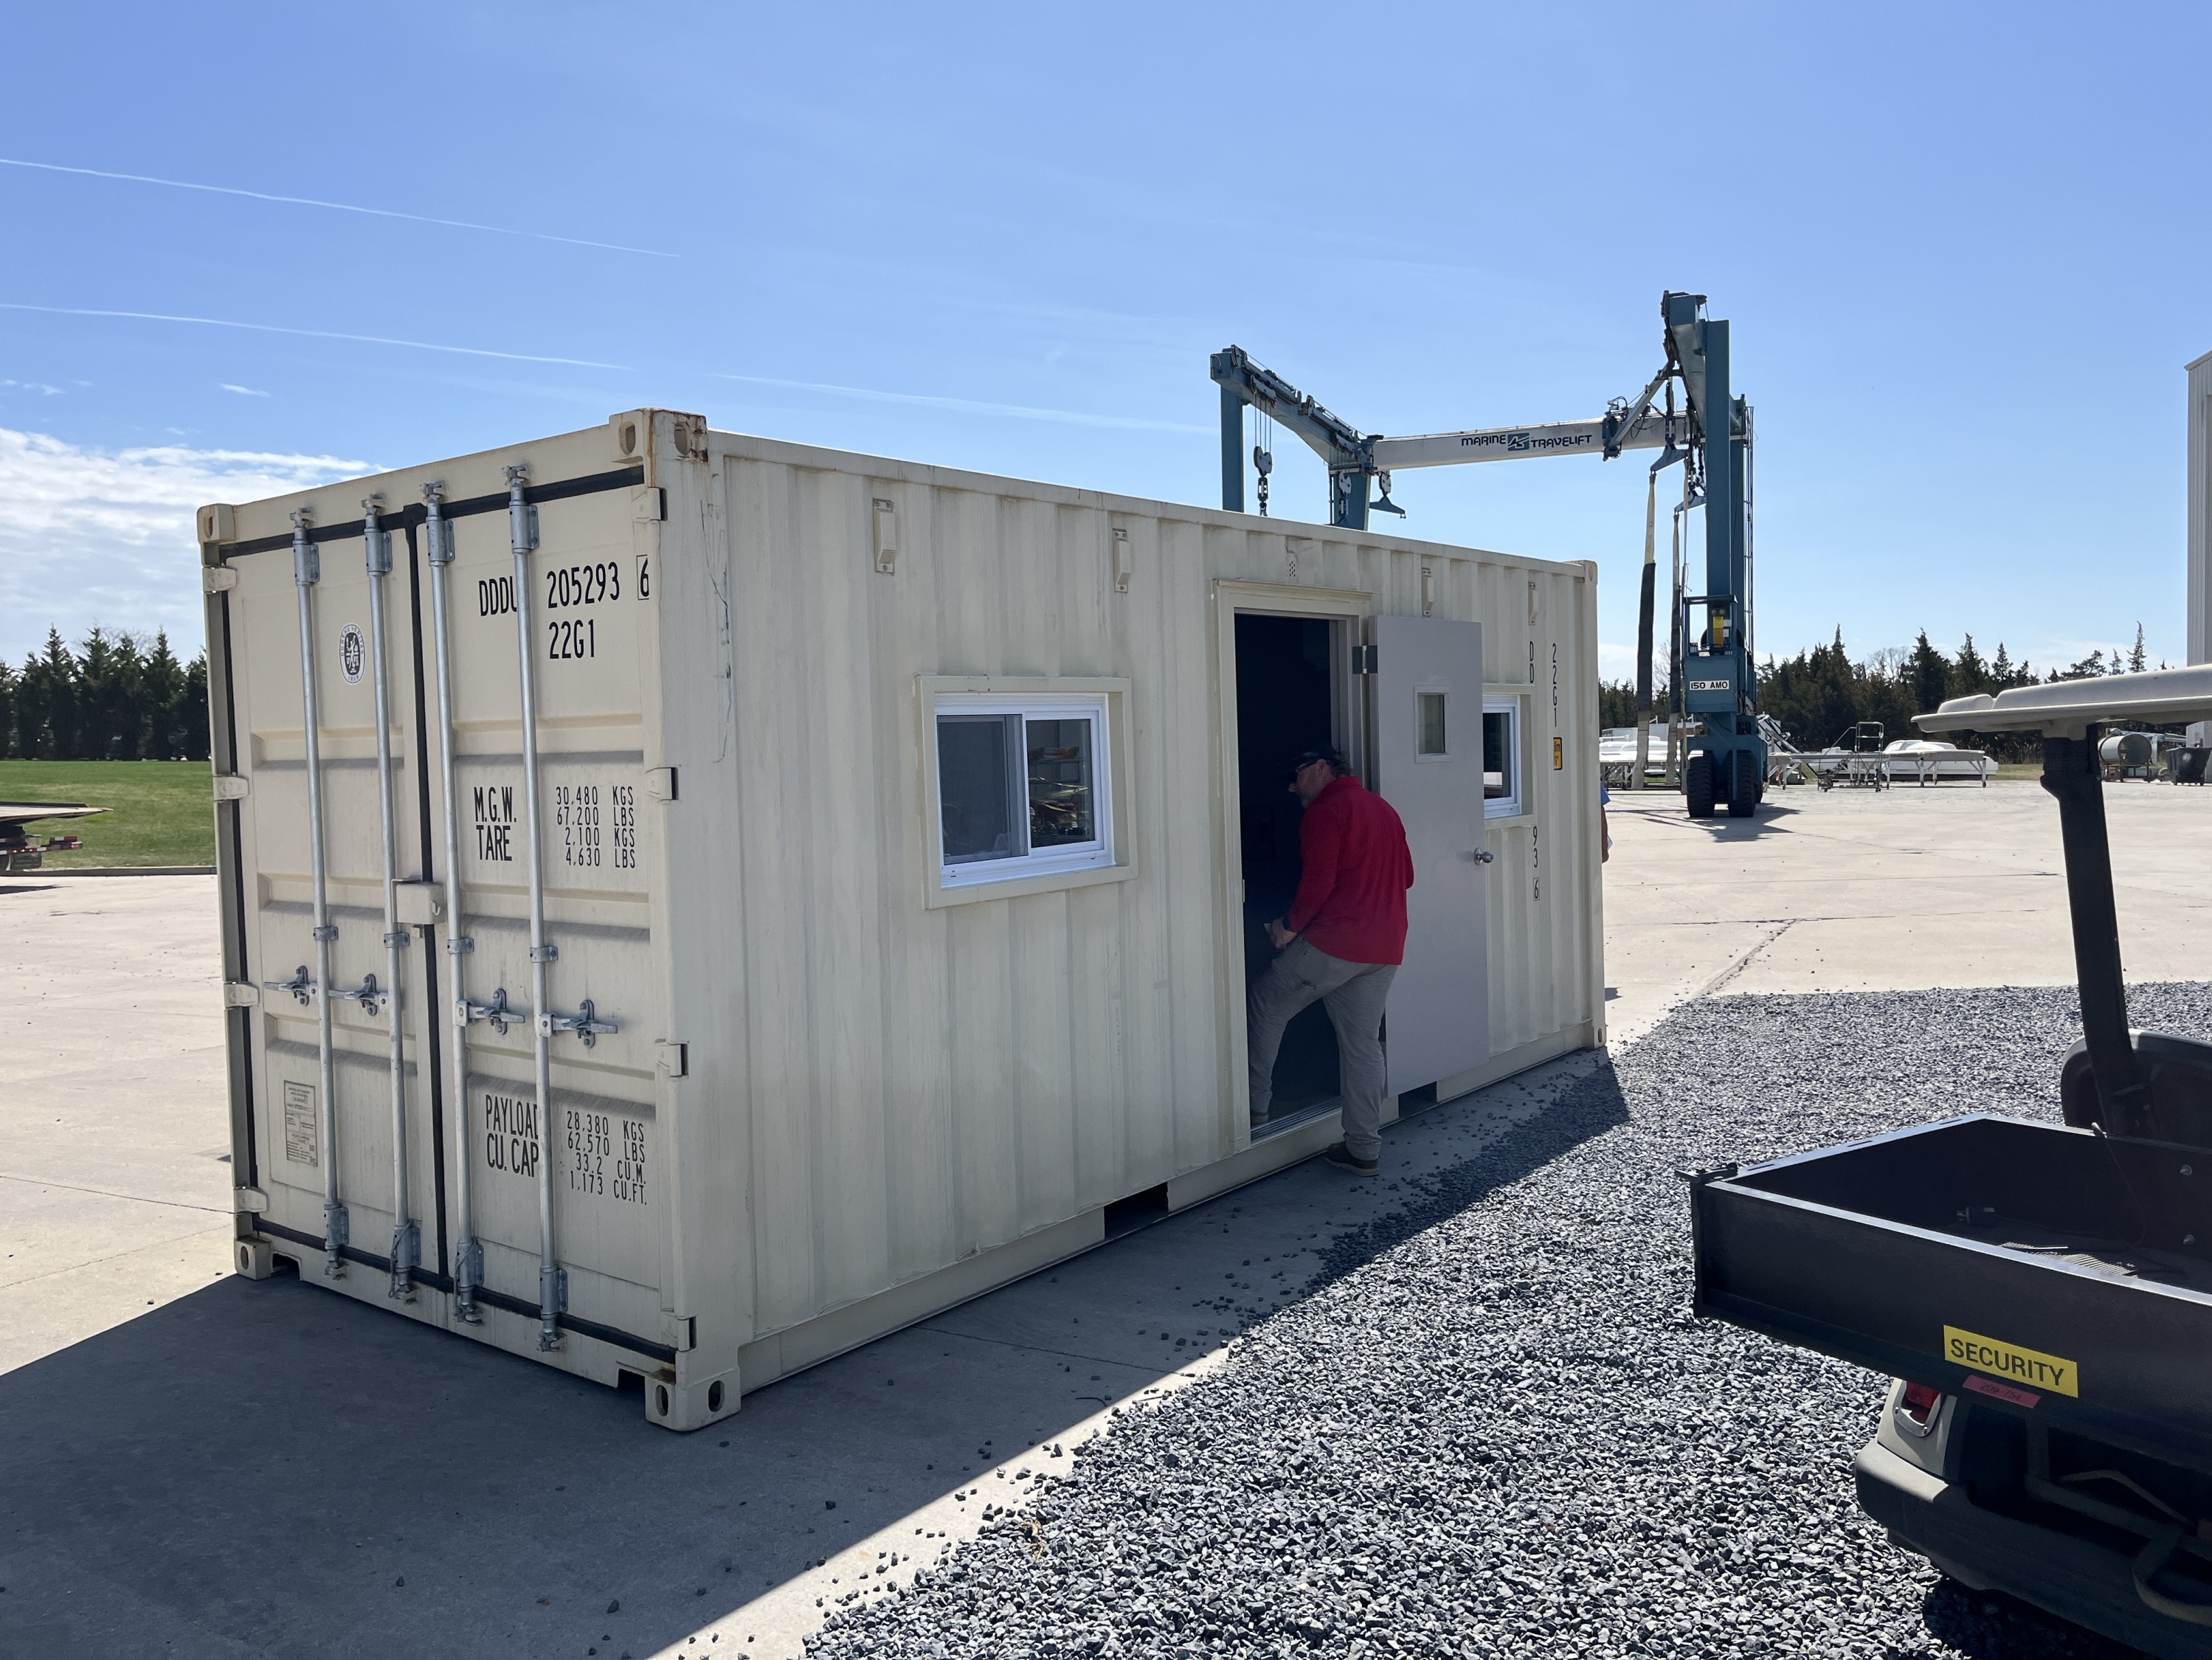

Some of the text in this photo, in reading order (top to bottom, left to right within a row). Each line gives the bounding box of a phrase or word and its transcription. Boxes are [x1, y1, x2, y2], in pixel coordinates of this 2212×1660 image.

[1461, 434, 1593, 449] MARINE TRAVELIFT
[546, 561, 620, 609] 205293
[640, 558, 649, 598] 6
[548, 618, 595, 659] 22G1
[1710, 681, 1728, 689] AMO
[474, 786, 634, 823] M.G.W. 30,480 KGS
[556, 806, 635, 827] 67,200 LBS
[475, 825, 635, 862] TARE 2,100 KGS
[565, 847, 636, 868] 4,630 LBS
[567, 1110, 609, 1135] 28,380
[623, 1120, 645, 1143] KGS
[486, 1132, 508, 1172] CU.
[576, 1152, 603, 1175] 33.2
[617, 1160, 646, 1185] CU.M.
[567, 1131, 646, 1163] 62,570 LBS
[570, 1170, 647, 1206] 1,173 CU.FT.
[1950, 1338, 2064, 1386] SECURITY
